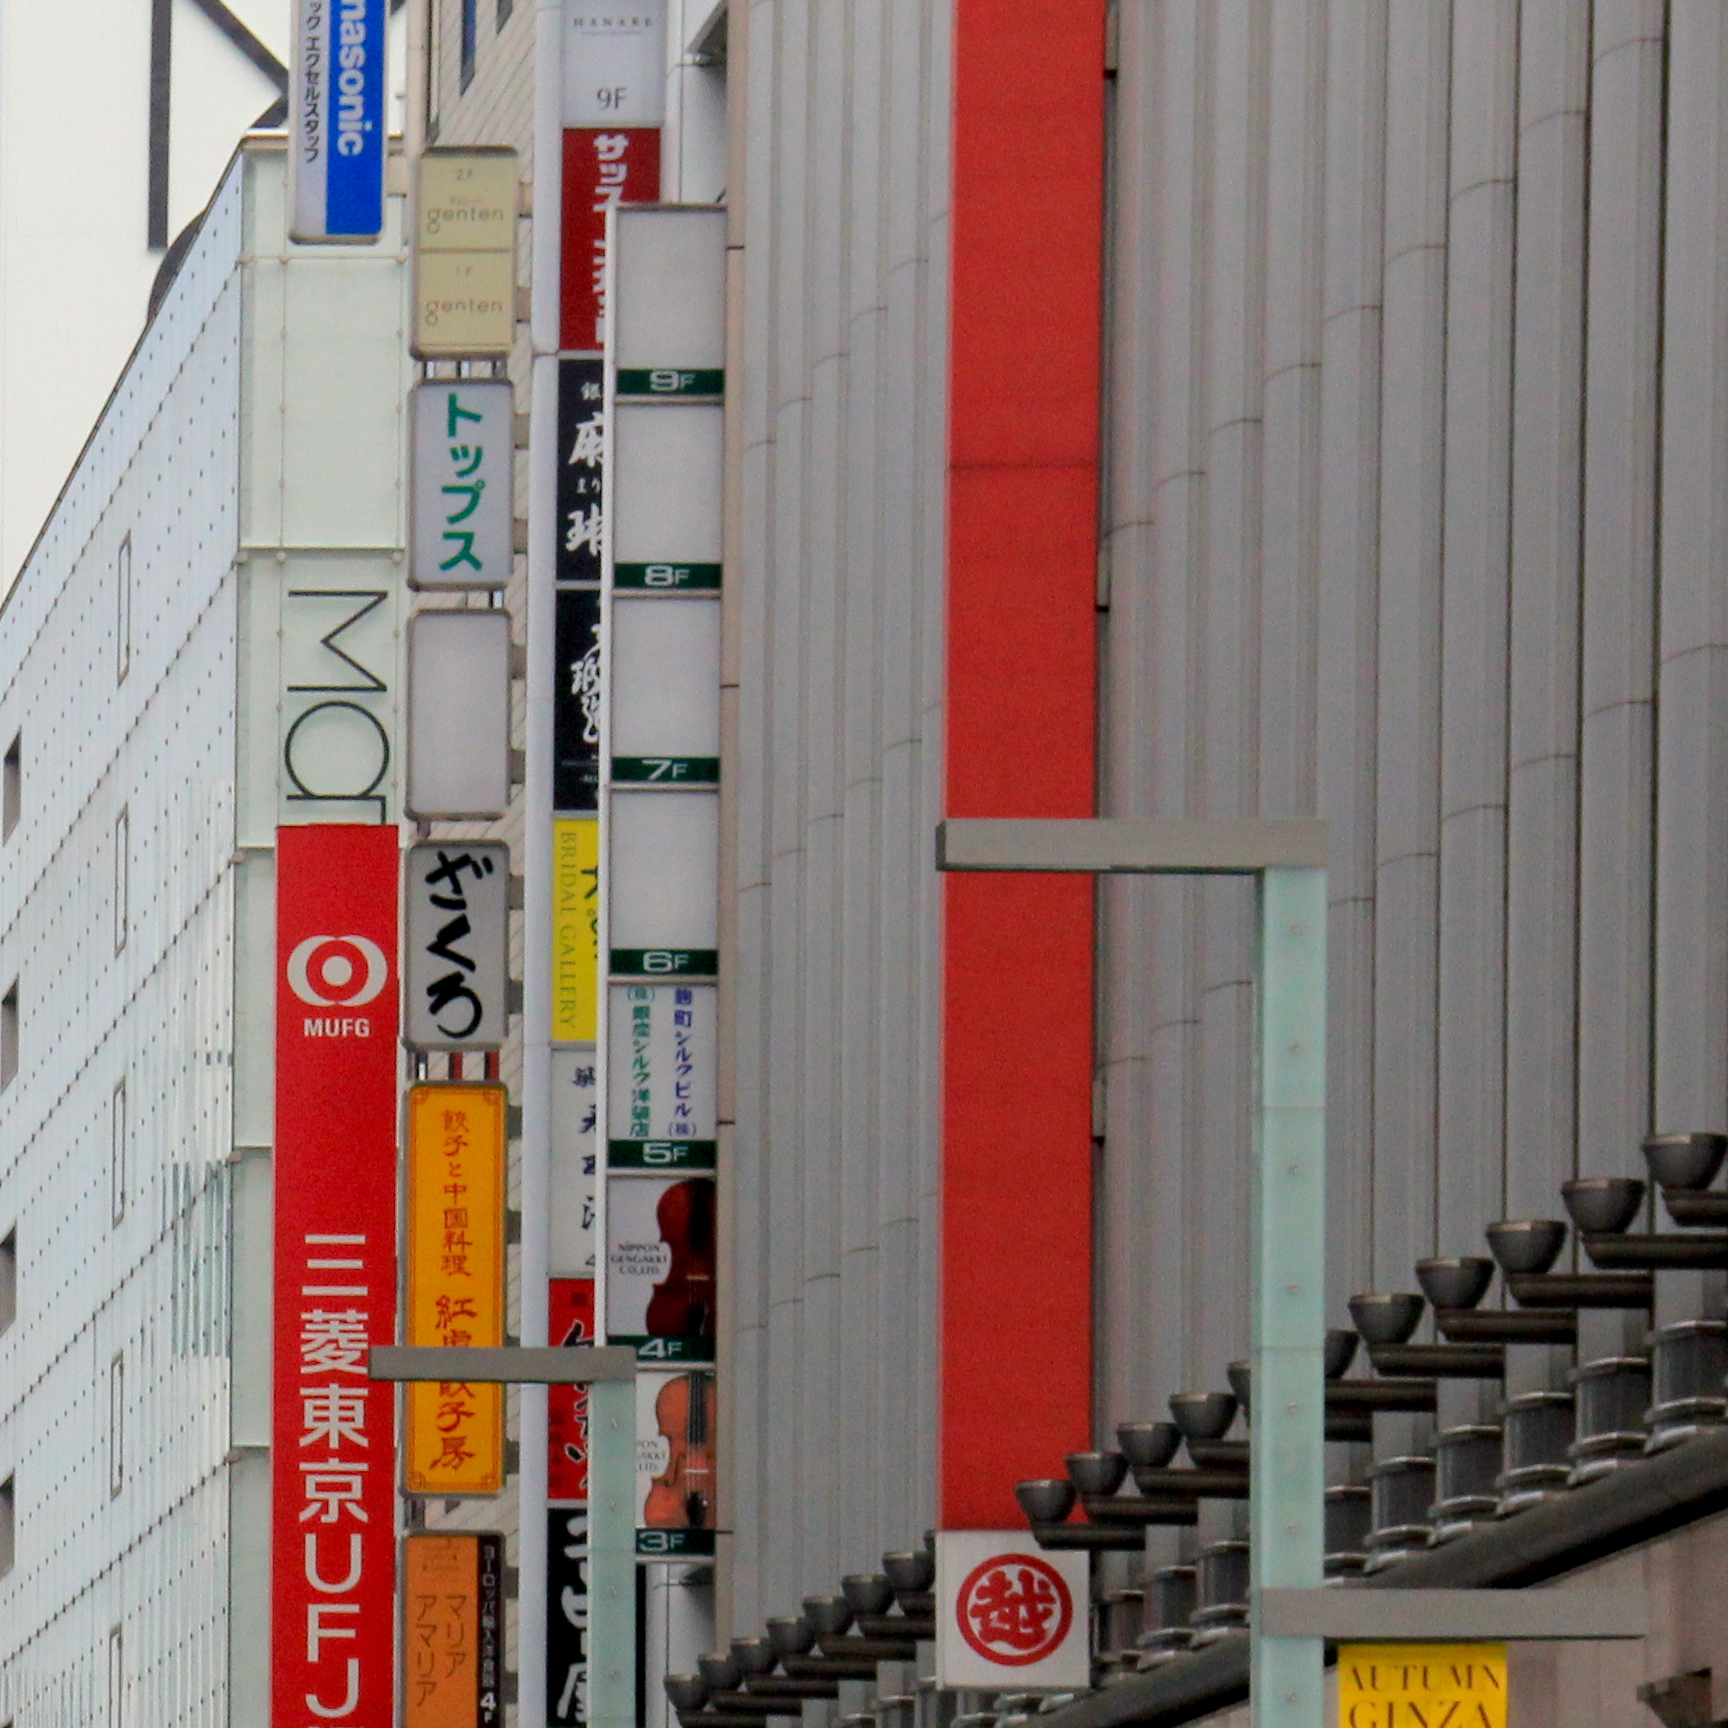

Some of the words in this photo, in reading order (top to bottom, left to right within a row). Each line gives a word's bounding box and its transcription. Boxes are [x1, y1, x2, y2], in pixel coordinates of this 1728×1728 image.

[596, 87, 627, 110] 9F
[426, 207, 505, 234] genten
[425, 298, 503, 327] genten
[648, 369, 696, 392] 9F
[439, 392, 485, 571] トップス
[643, 565, 691, 586] 8F
[641, 759, 688, 781] 7F
[560, 831, 578, 917] BRIDAL
[424, 850, 493, 1040] ざくろ
[642, 951, 690, 973] 6F
[558, 923, 577, 1029] GALLERY
[303, 1017, 371, 1038] MUFG
[641, 1142, 687, 1164] 5F
[638, 1337, 683, 1358] 4F
[638, 1530, 686, 1551] 3F
[444, 1595, 467, 1679] マリア
[415, 1595, 437, 1708] アマリア
[1347, 1663, 1502, 1695] AUTUMN
